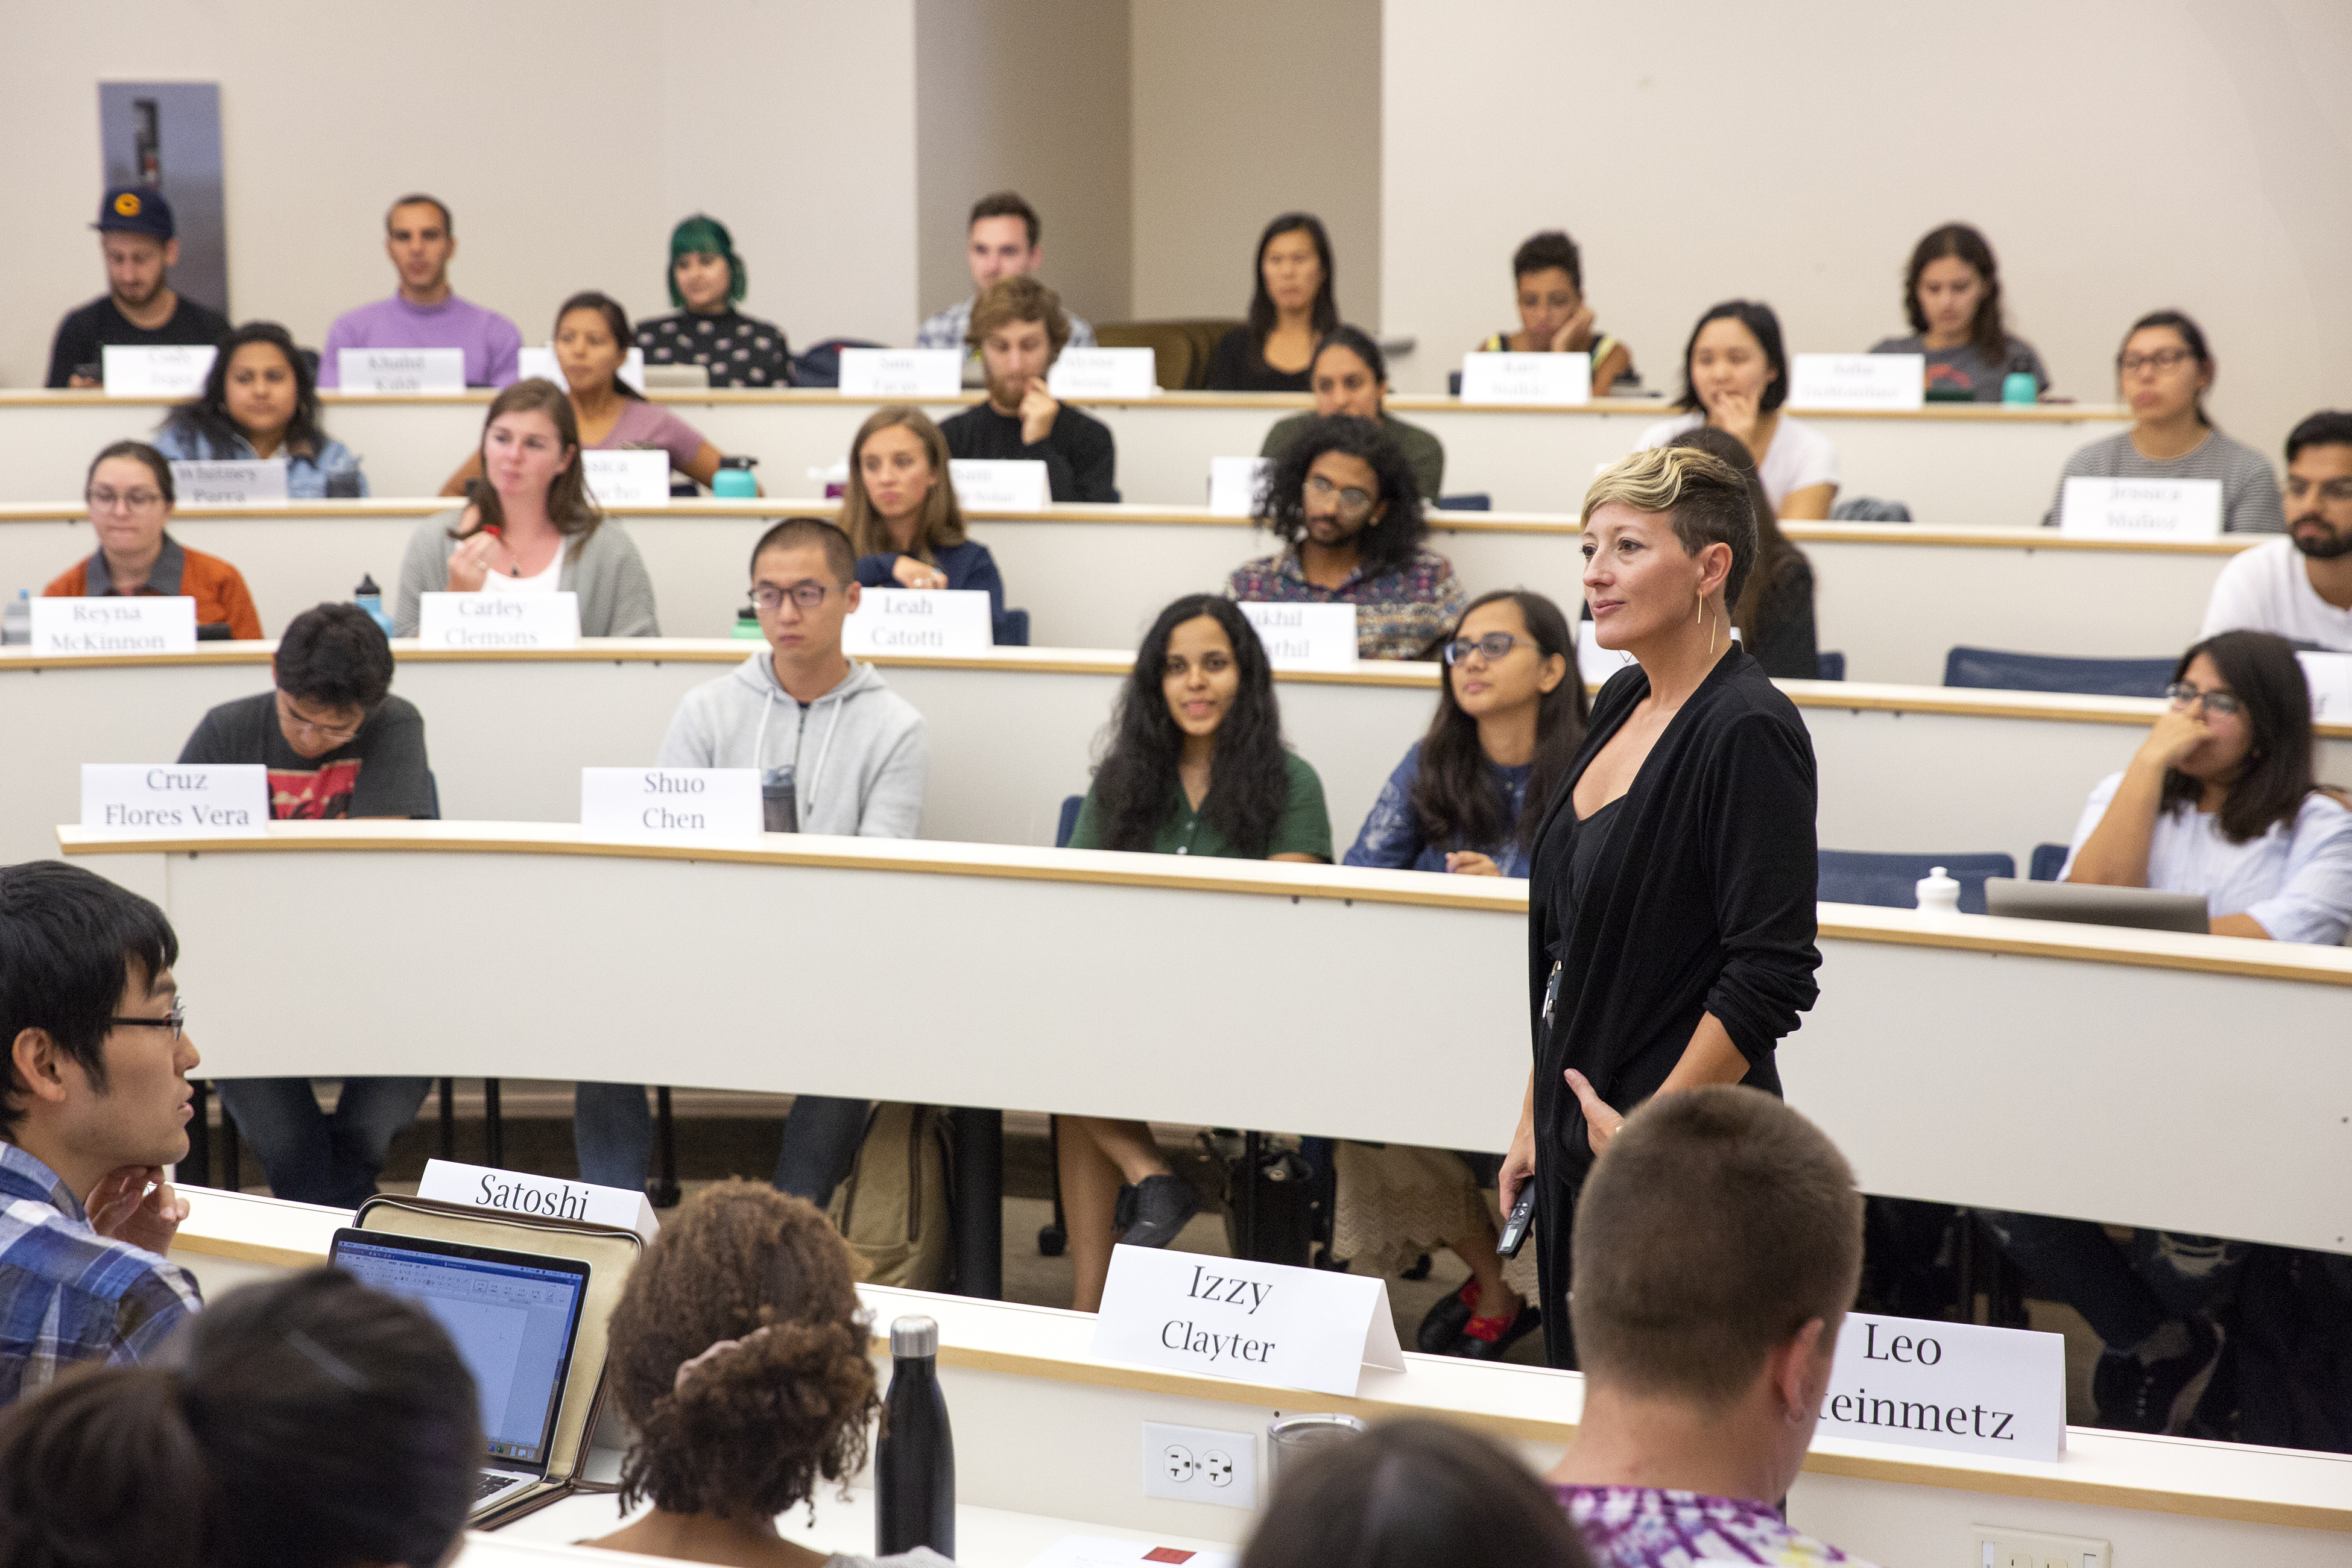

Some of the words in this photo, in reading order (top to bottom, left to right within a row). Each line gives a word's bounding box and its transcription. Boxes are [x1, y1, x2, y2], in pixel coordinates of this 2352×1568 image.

[73, 604, 142, 625] Reyna
[458, 598, 528, 621] Carley
[884, 595, 933, 615] Leah
[1253, 608, 1303, 627] ikhil
[51, 633, 165, 650] McKinnon
[444, 627, 539, 645] Clemons
[871, 625, 943, 647] Catotti
[147, 768, 209, 791] Cruz
[643, 771, 706, 794] Shuo
[105, 803, 183, 826] Flores
[191, 805, 250, 826] Vera
[642, 807, 706, 829] Chen
[475, 1174, 589, 1221] Satoshi
[1186, 1263, 1274, 1316] Izzy
[1160, 1319, 1277, 1364] Clayter
[1863, 1323, 1942, 1365] Leo
